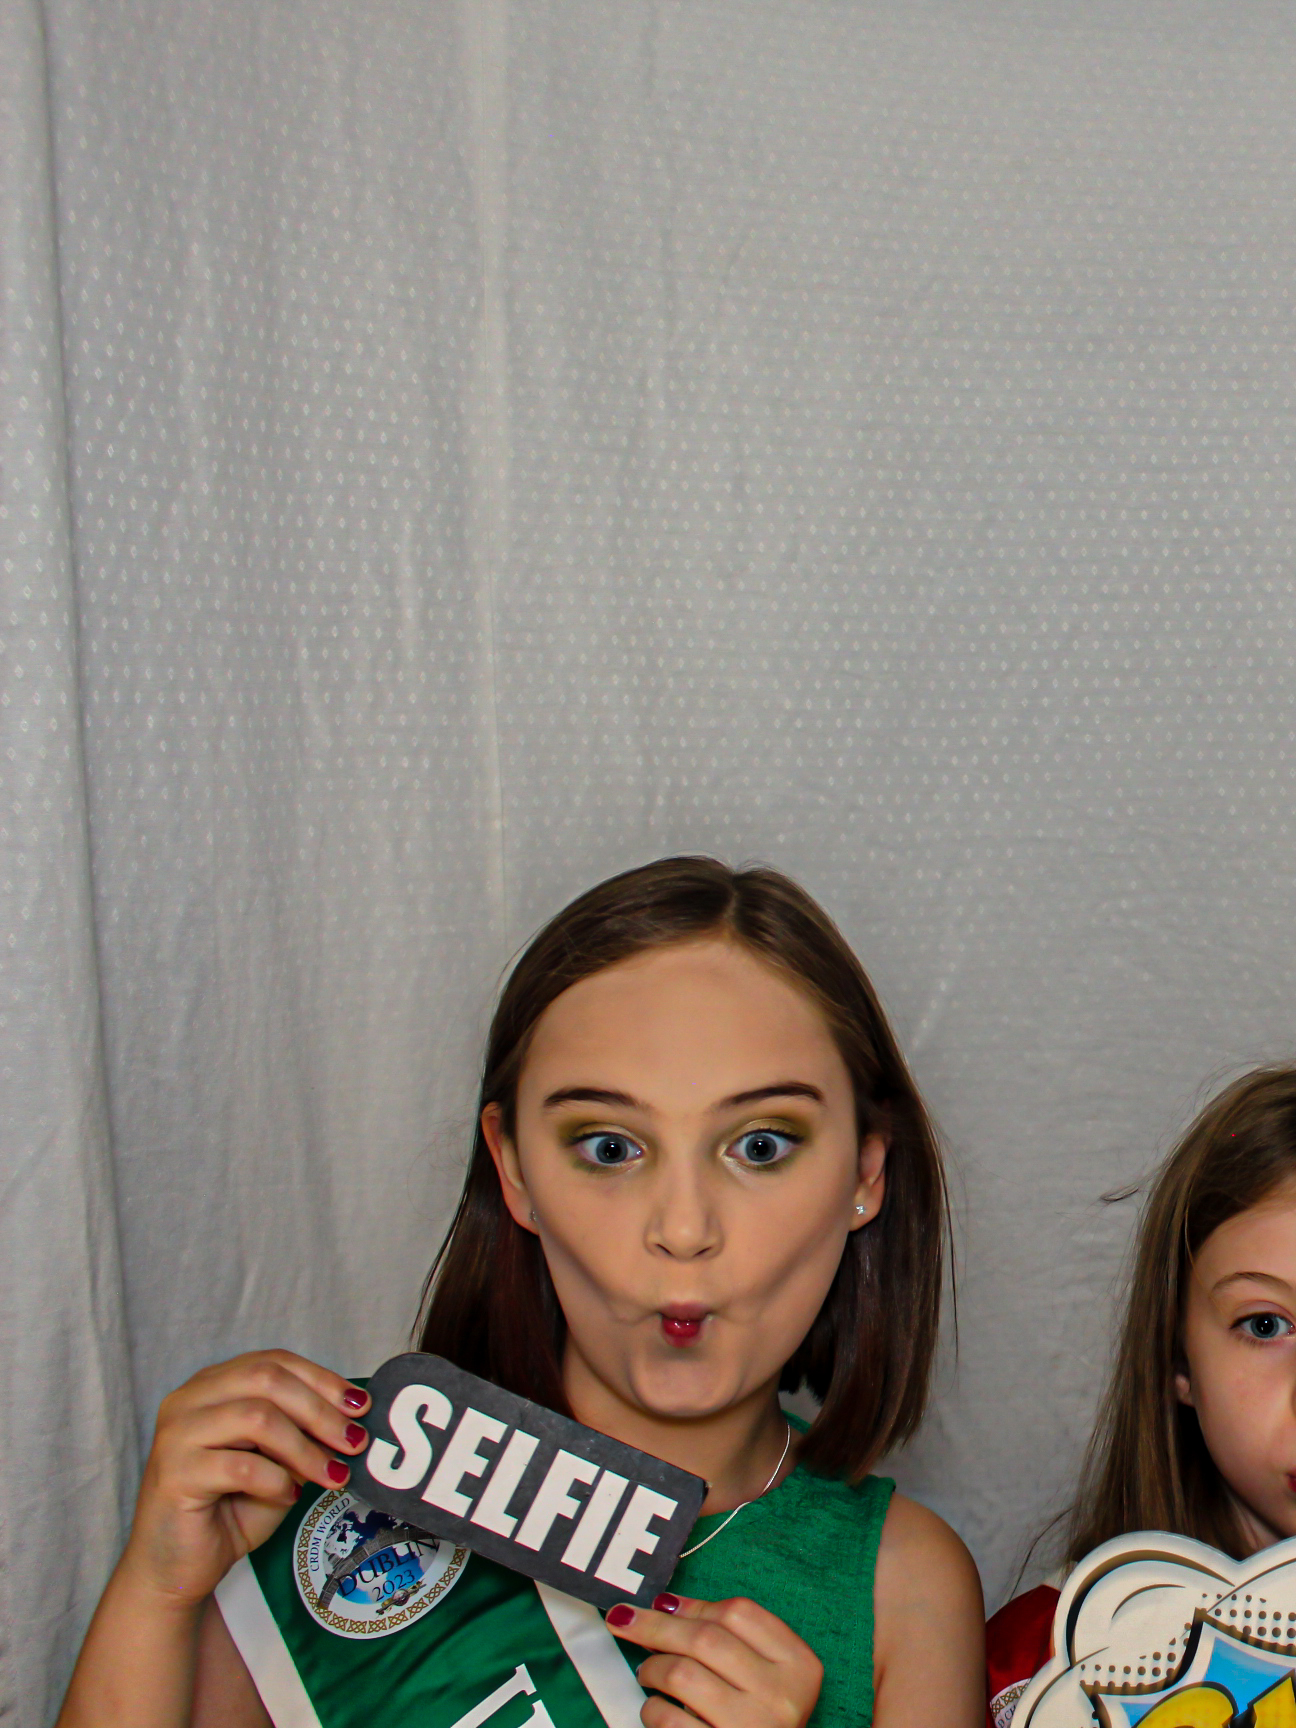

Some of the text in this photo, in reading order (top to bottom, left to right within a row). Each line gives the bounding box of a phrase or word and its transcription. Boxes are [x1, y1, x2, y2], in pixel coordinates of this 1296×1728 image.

[366, 1384, 678, 1595] SELFIE
[309, 1497, 351, 1572] CRDM WORLD
[336, 1535, 441, 1597] DUBLIN
[372, 1569, 416, 1602] 2023
